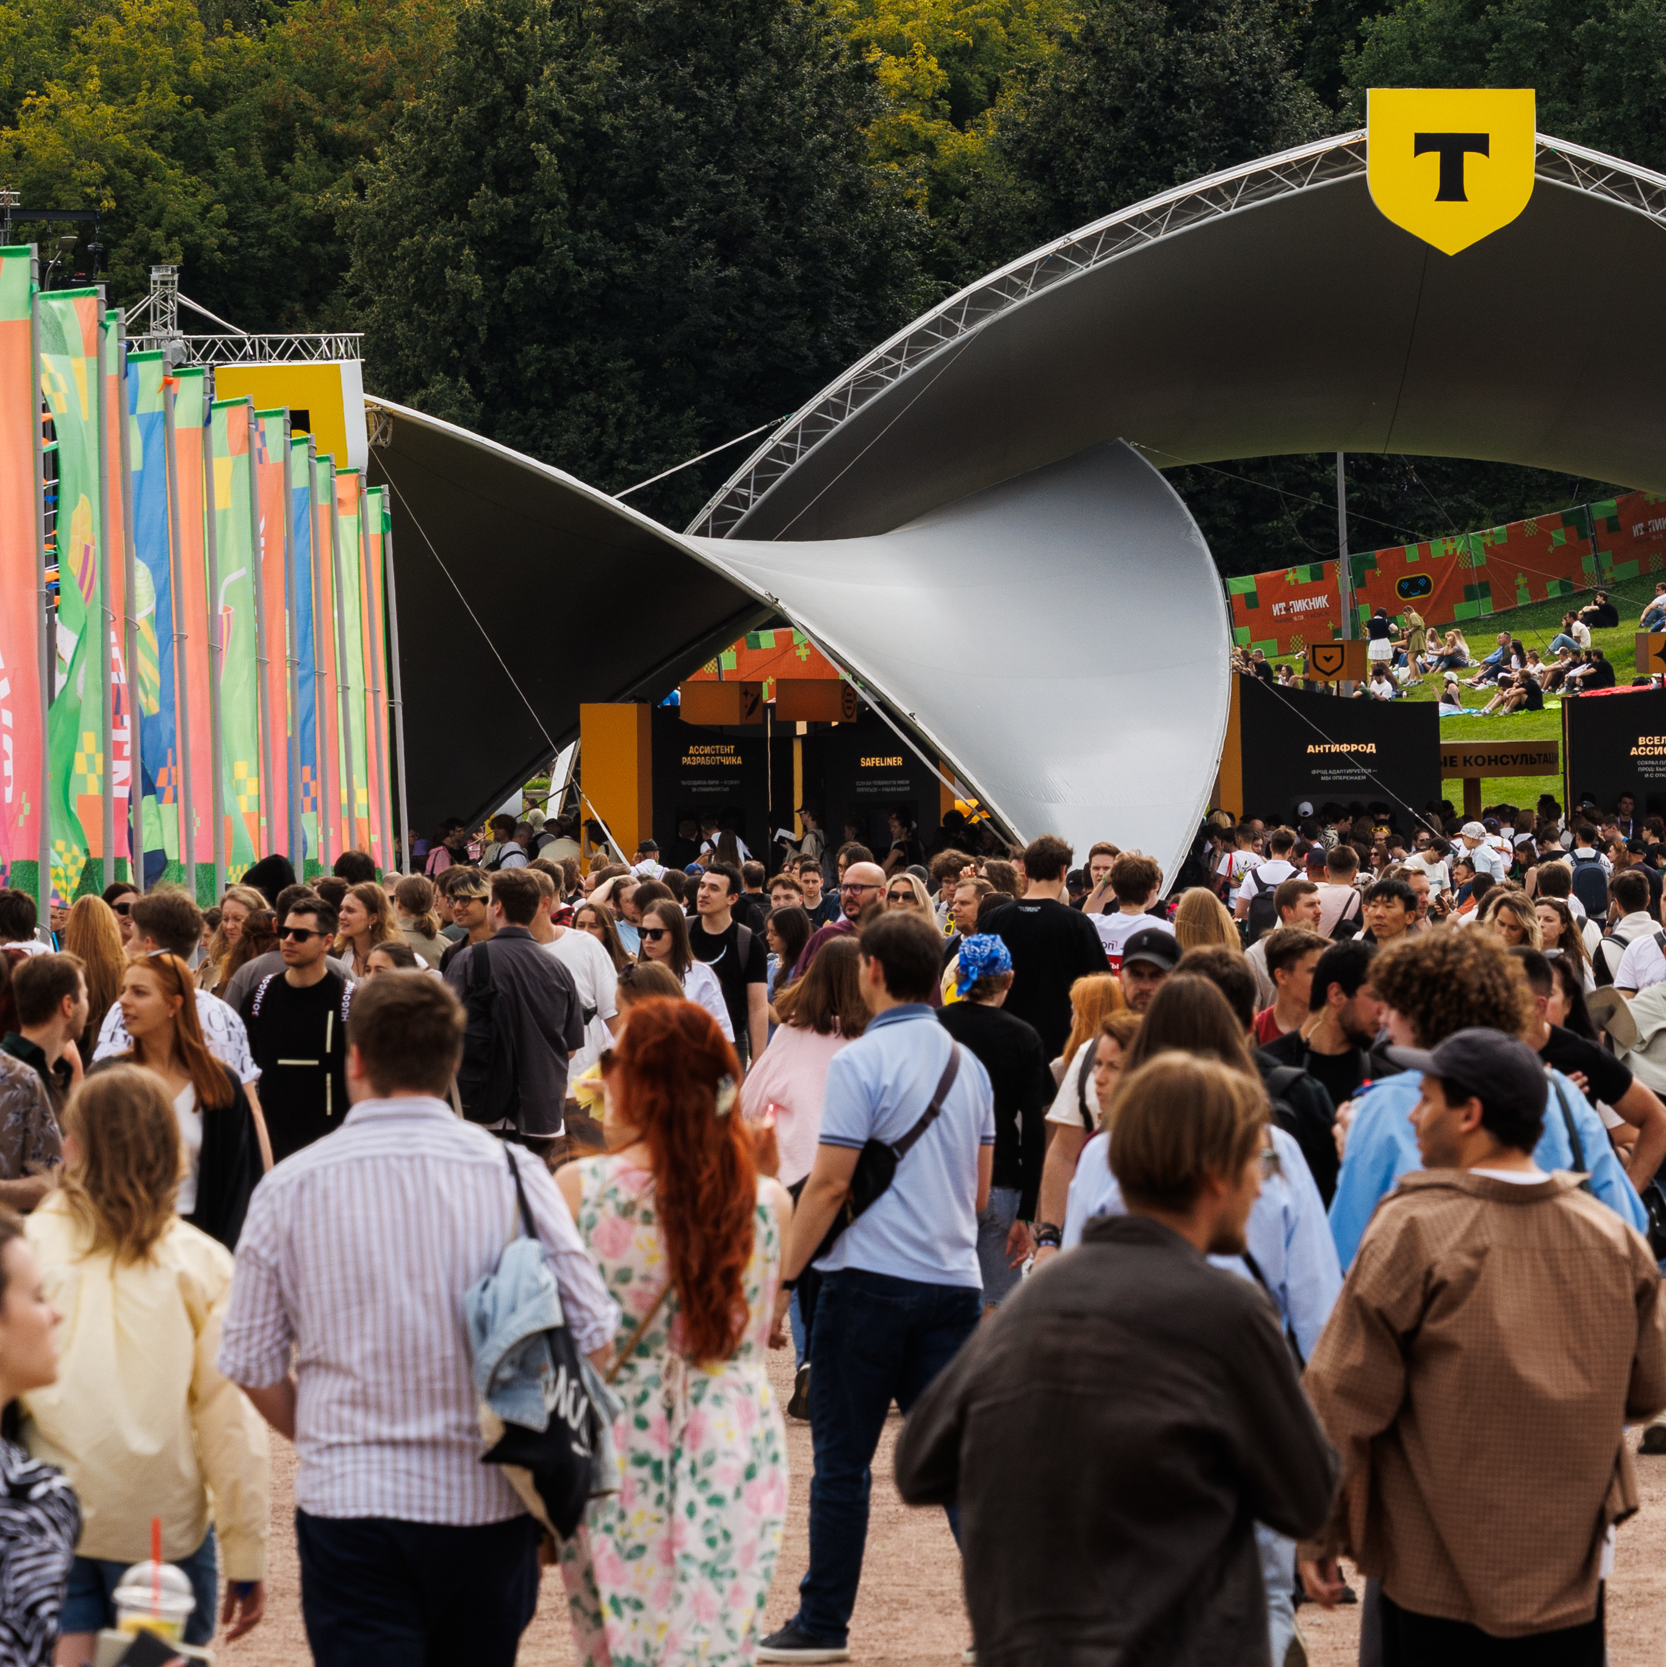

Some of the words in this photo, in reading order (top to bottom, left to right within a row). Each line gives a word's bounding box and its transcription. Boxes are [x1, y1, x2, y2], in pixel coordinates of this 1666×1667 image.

[1272, 594, 1330, 616] ИТ-ПИКНИК
[688, 745, 735, 755] АССИСТЕНТ
[1306, 743, 1377, 754] АНТИФРОД
[681, 756, 743, 765] РАЗРАБОТЧИКА
[860, 756, 903, 767] SAFELINER
